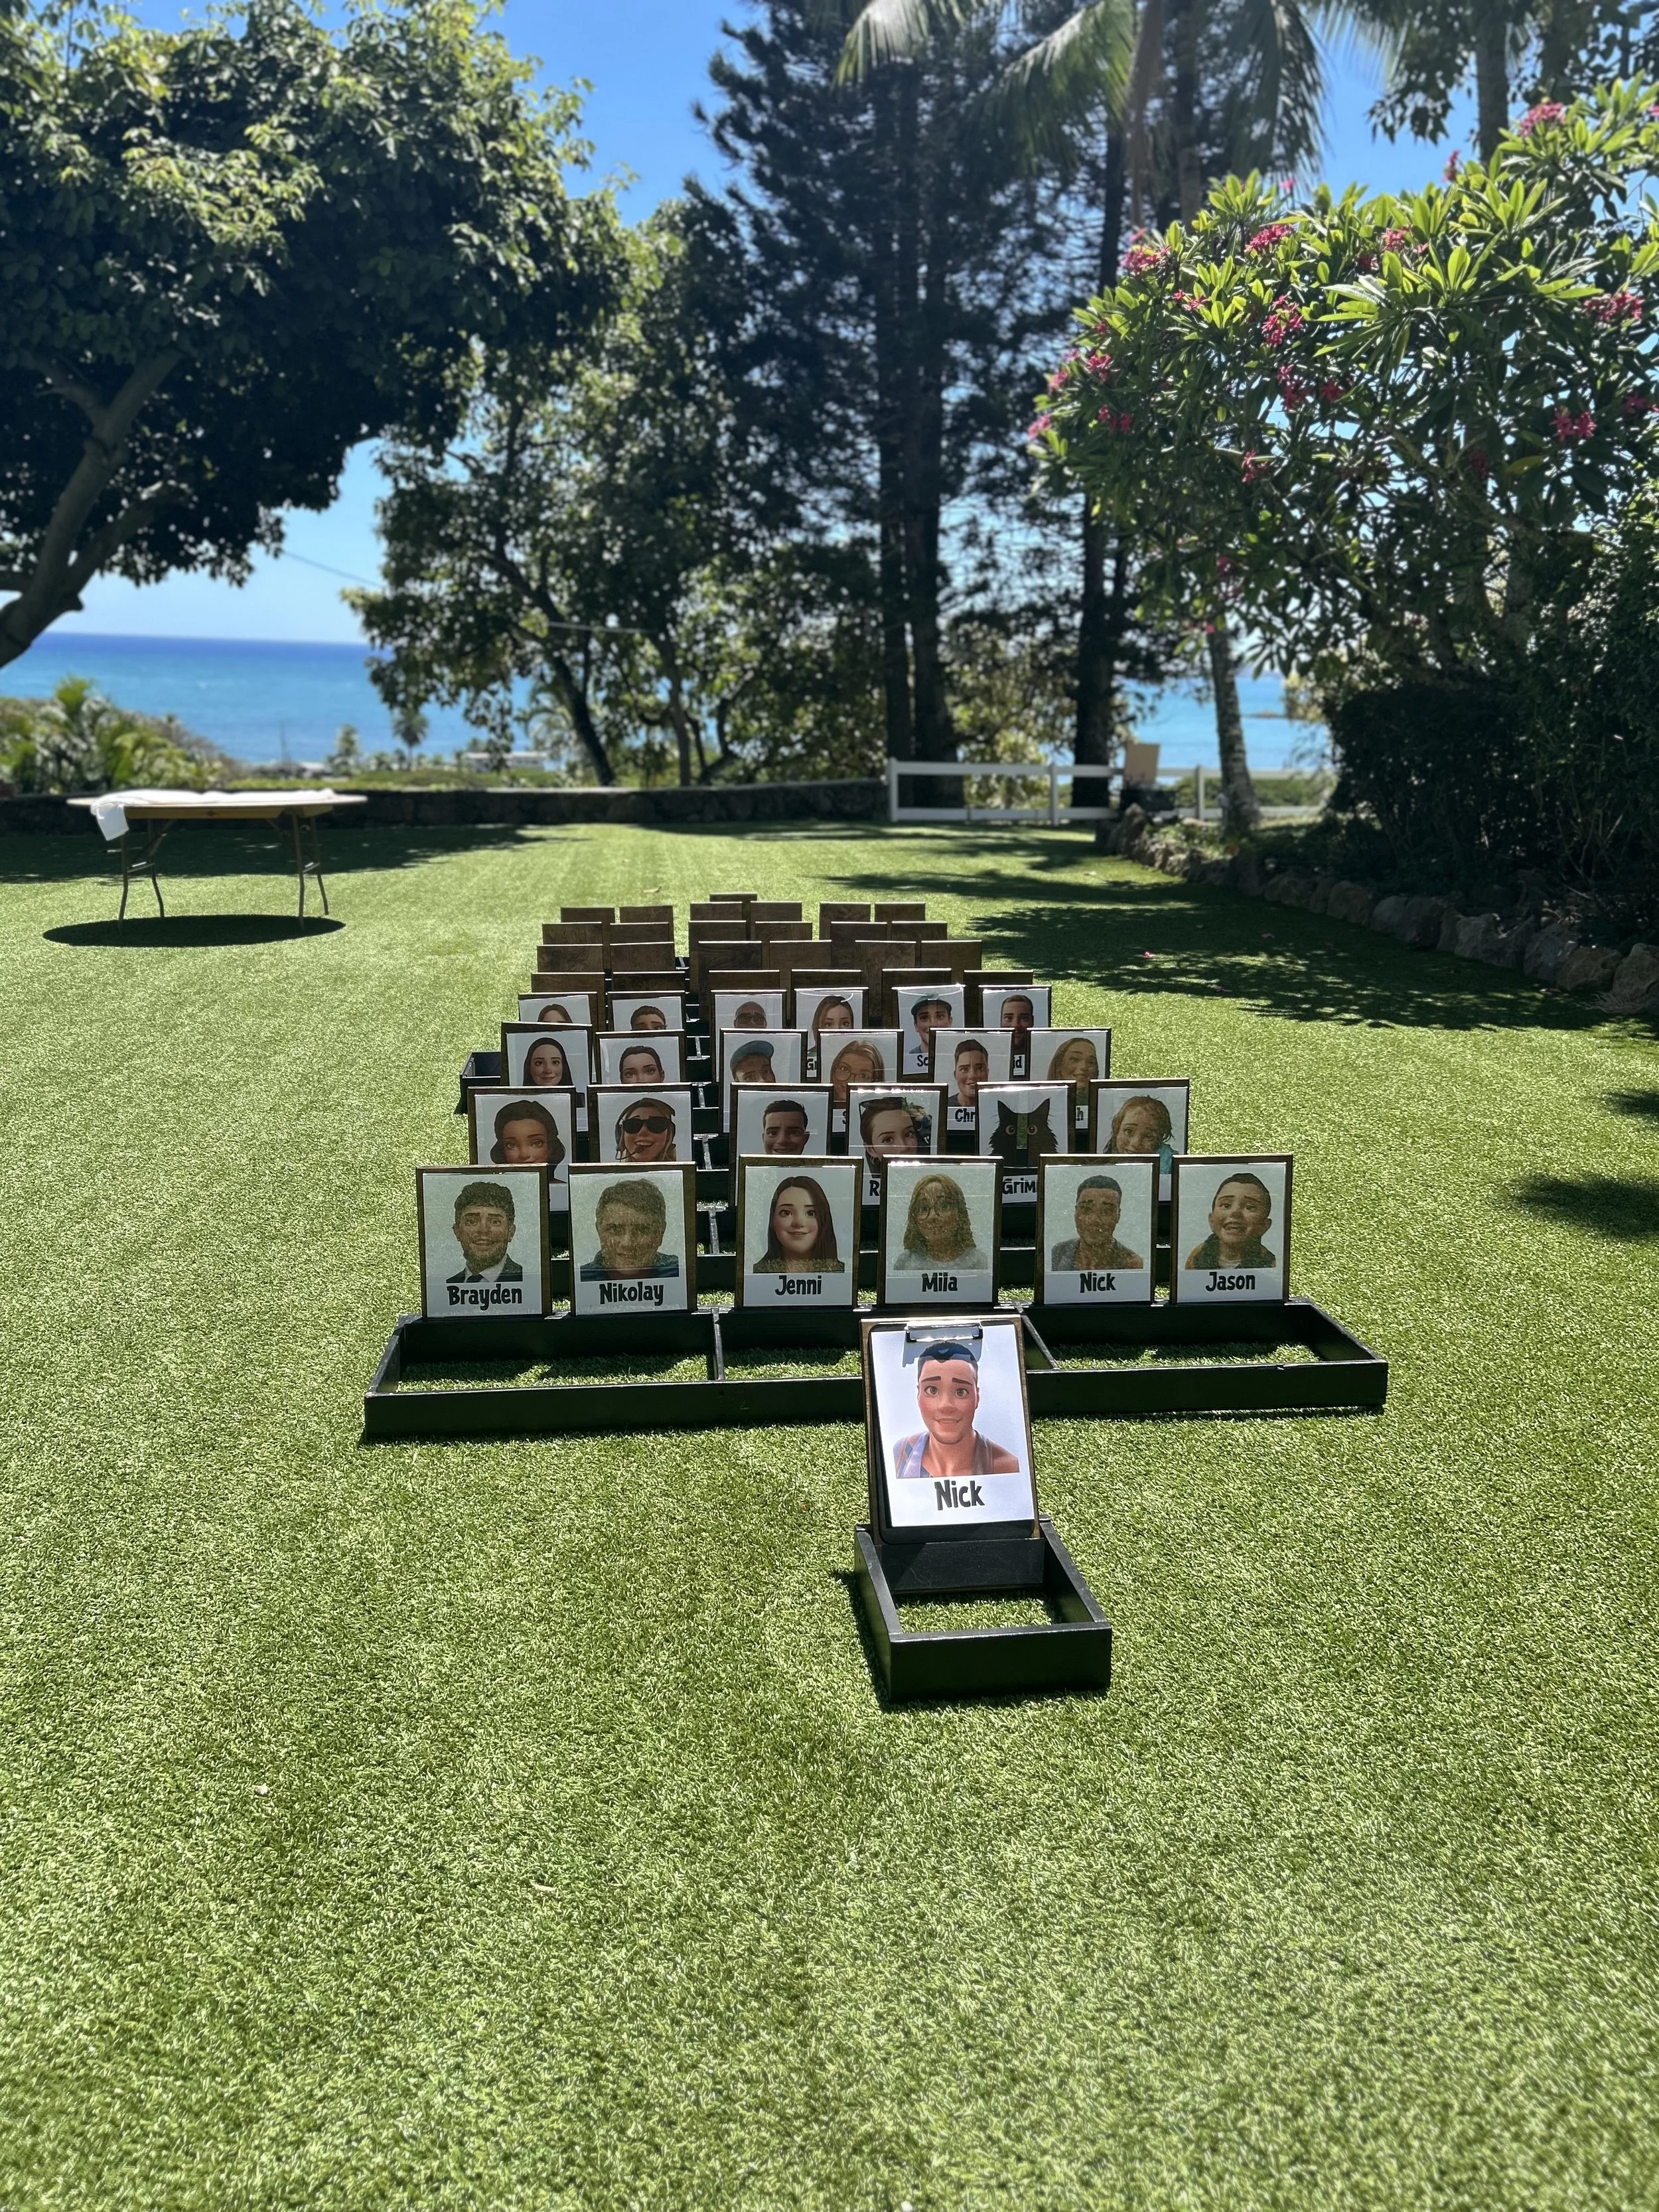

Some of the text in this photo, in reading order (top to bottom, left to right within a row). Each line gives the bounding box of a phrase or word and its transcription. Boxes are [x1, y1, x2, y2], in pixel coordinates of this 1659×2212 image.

[774, 1275, 822, 1295] Jenni
[922, 1272, 958, 1292] Mila
[1080, 1272, 1116, 1293] Nick
[1205, 1271, 1256, 1292] Jason
[446, 1283, 522, 1311] Brayden
[599, 1282, 664, 1306] Nikolay
[934, 1479, 985, 1511] Nick
